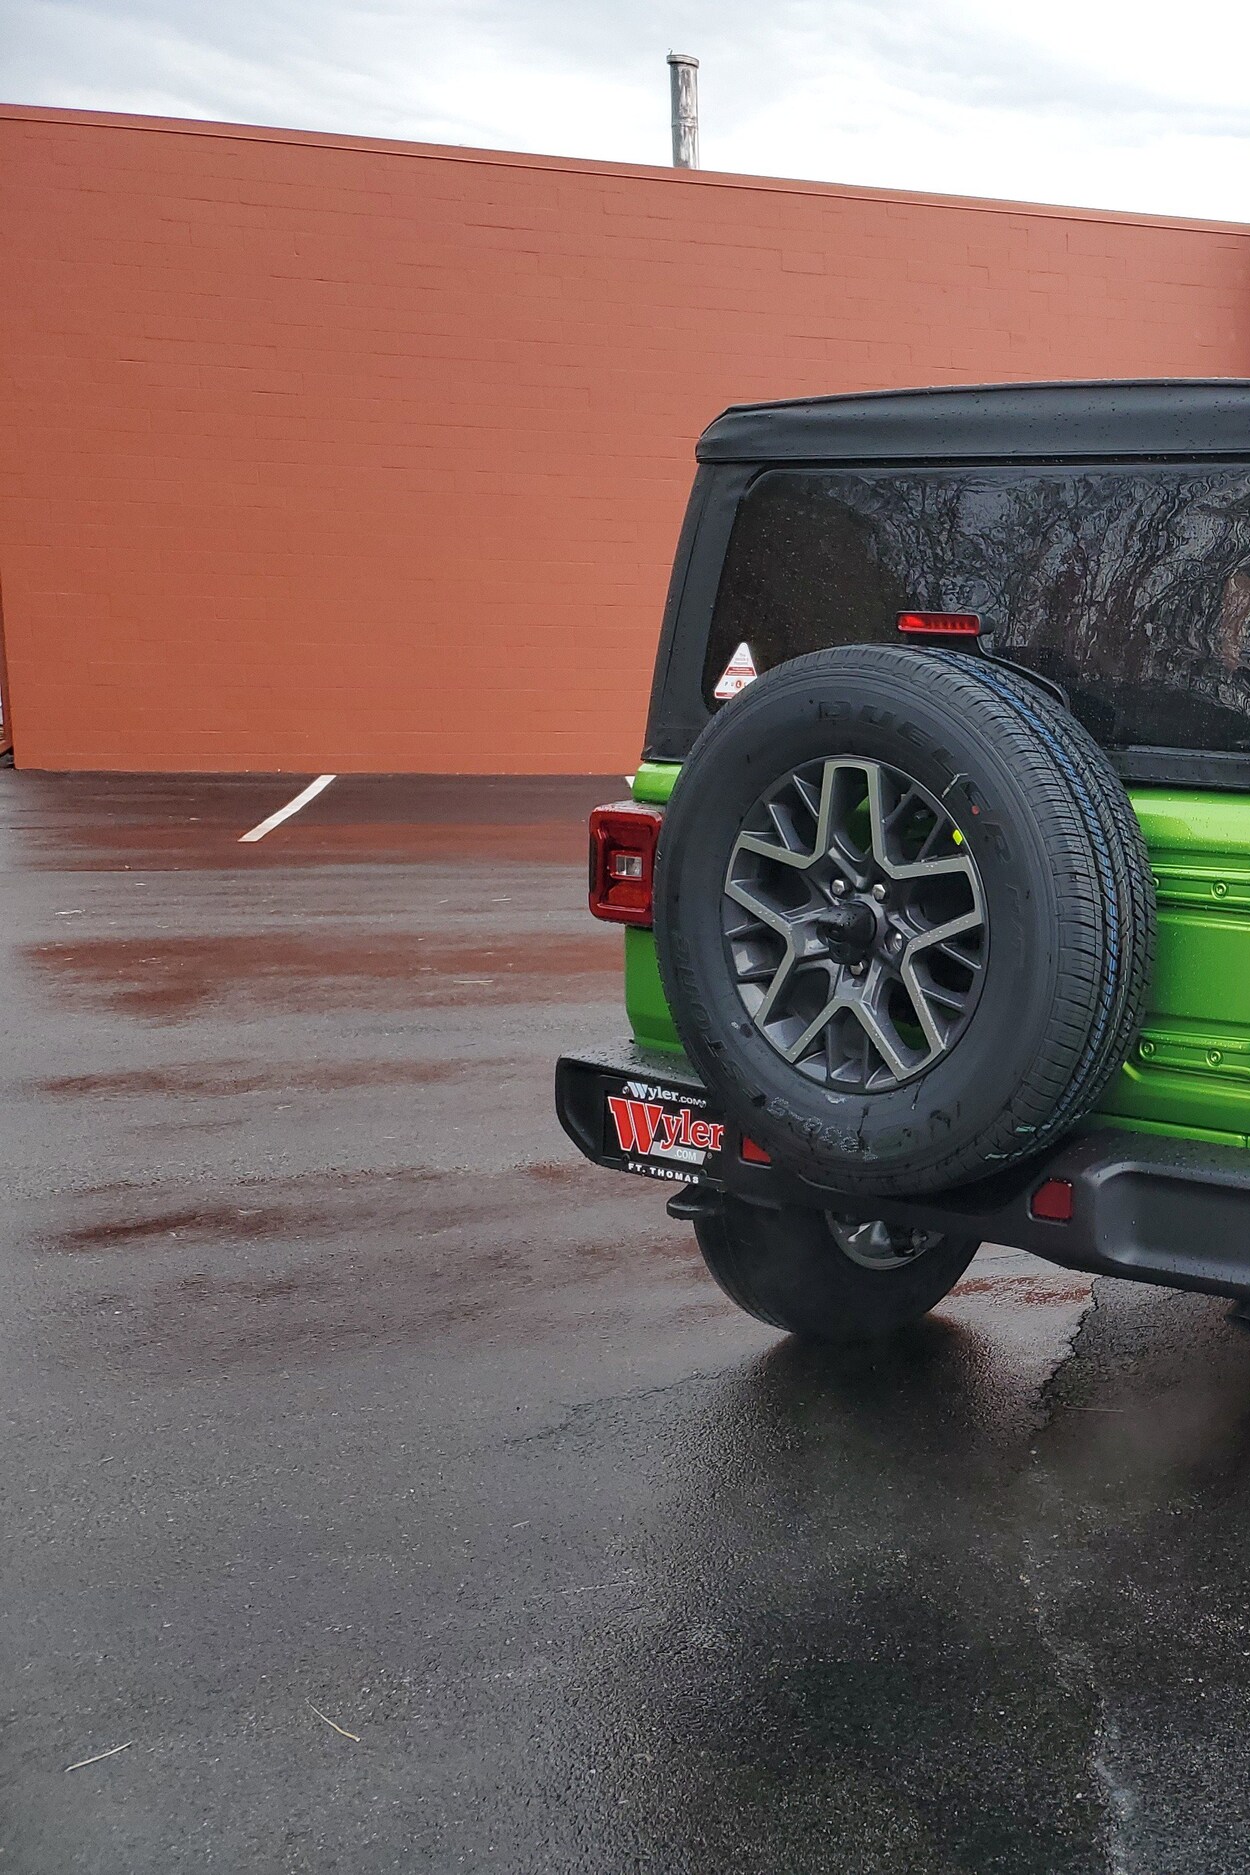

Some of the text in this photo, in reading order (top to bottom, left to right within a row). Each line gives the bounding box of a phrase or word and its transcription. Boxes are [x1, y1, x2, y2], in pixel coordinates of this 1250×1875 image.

[819, 701, 1012, 863] DUELER
[607, 1096, 725, 1155] Wyler
[628, 1163, 699, 1184] FT. THOMAS
